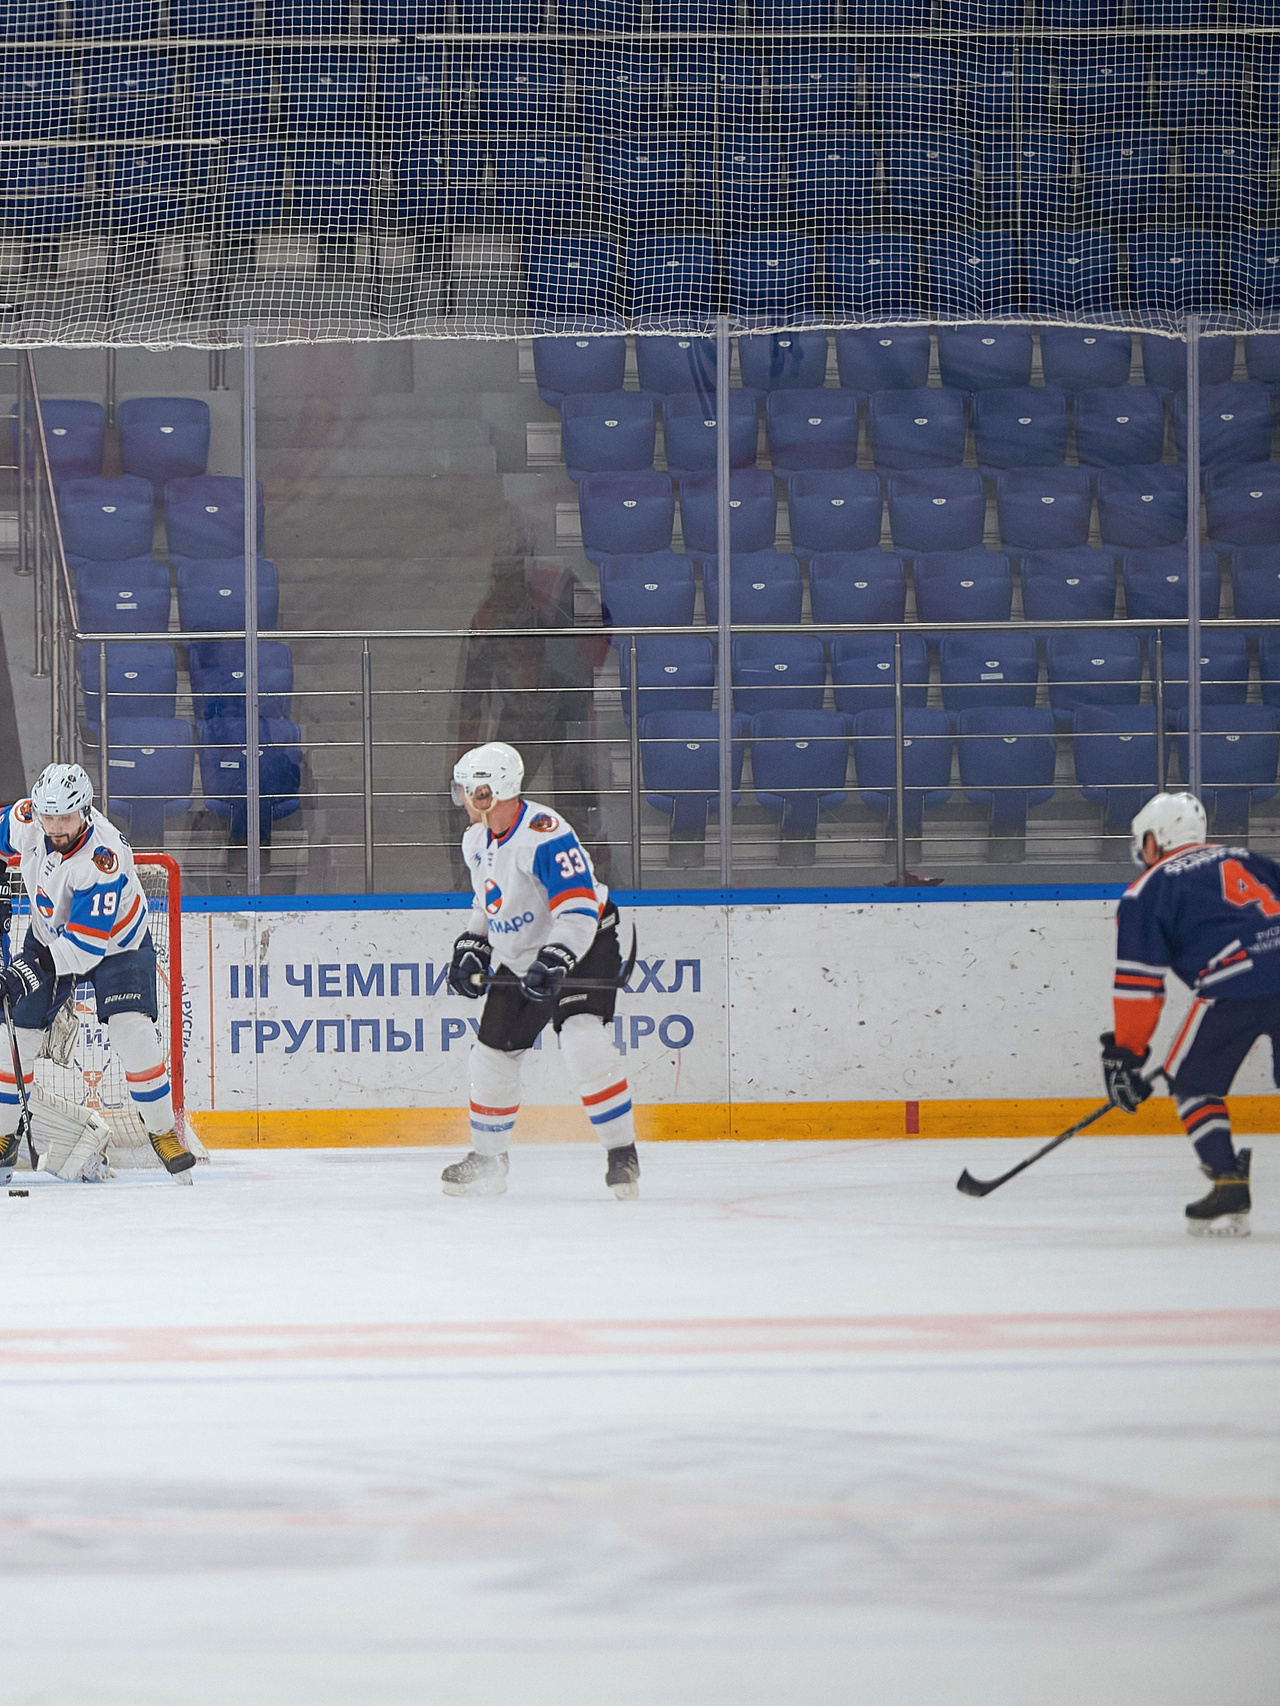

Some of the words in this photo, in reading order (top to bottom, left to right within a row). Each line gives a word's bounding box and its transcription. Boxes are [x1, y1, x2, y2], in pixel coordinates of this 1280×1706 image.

[555, 847, 587, 879] 33
[90, 891, 117, 917] 19
[230, 1018, 424, 1054] ГРУППЫ
